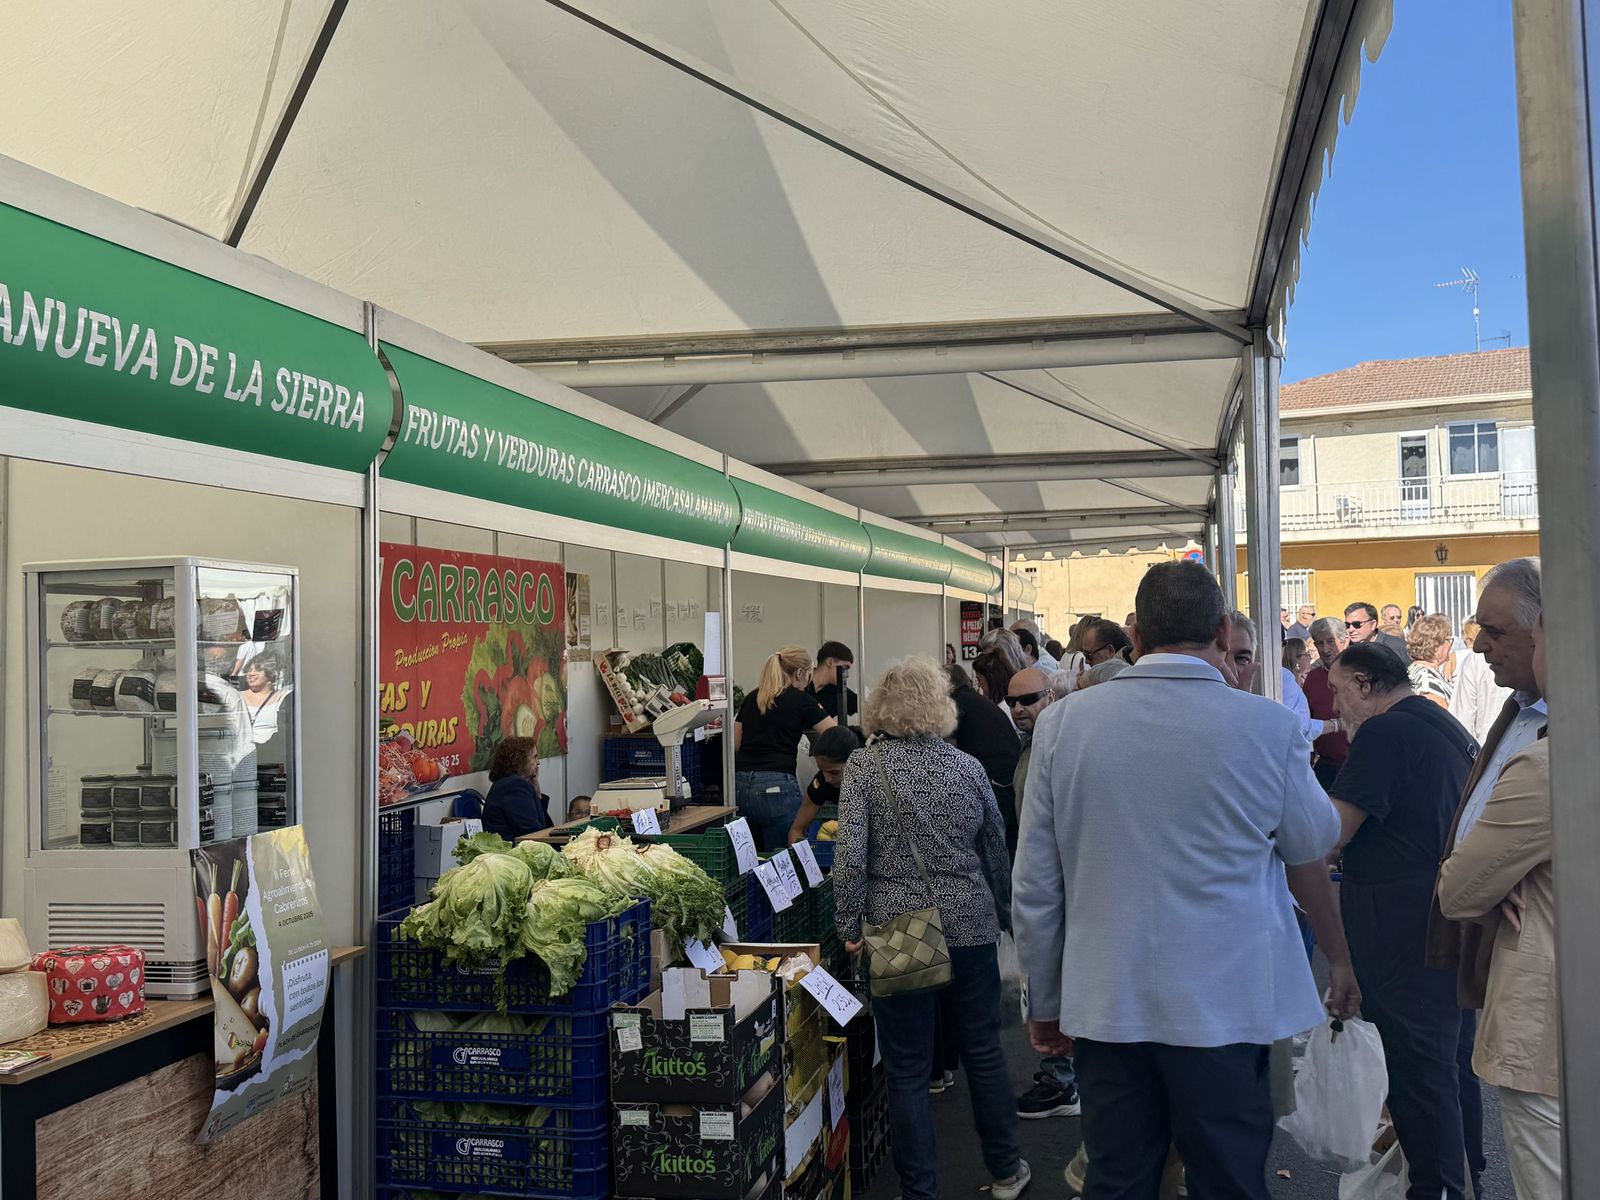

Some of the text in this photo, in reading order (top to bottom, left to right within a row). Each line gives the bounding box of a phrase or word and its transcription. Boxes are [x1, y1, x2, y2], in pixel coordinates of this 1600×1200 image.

[169, 335, 219, 394] DE
[224, 352, 263, 407] LA
[270, 367, 365, 433] SIERRA
[404, 404, 480, 459] FRUTAS
[483, 427, 496, 462] Y
[497, 431, 576, 485] VERDURAS
[577, 457, 641, 502] CARRASCO
[391, 558, 555, 625] CARRASCO
[441, 631, 468, 653] Propia
[962, 646, 982, 659] 13
[421, 680, 431, 708] Y
[451, 754, 460, 766] 25
[289, 978, 325, 1000] con todos los
[468, 1047, 502, 1057] CARRASCO
[650, 1052, 707, 1076] kittos
[471, 1137, 504, 1148] CARRASCO
[660, 1149, 716, 1174] kittos
